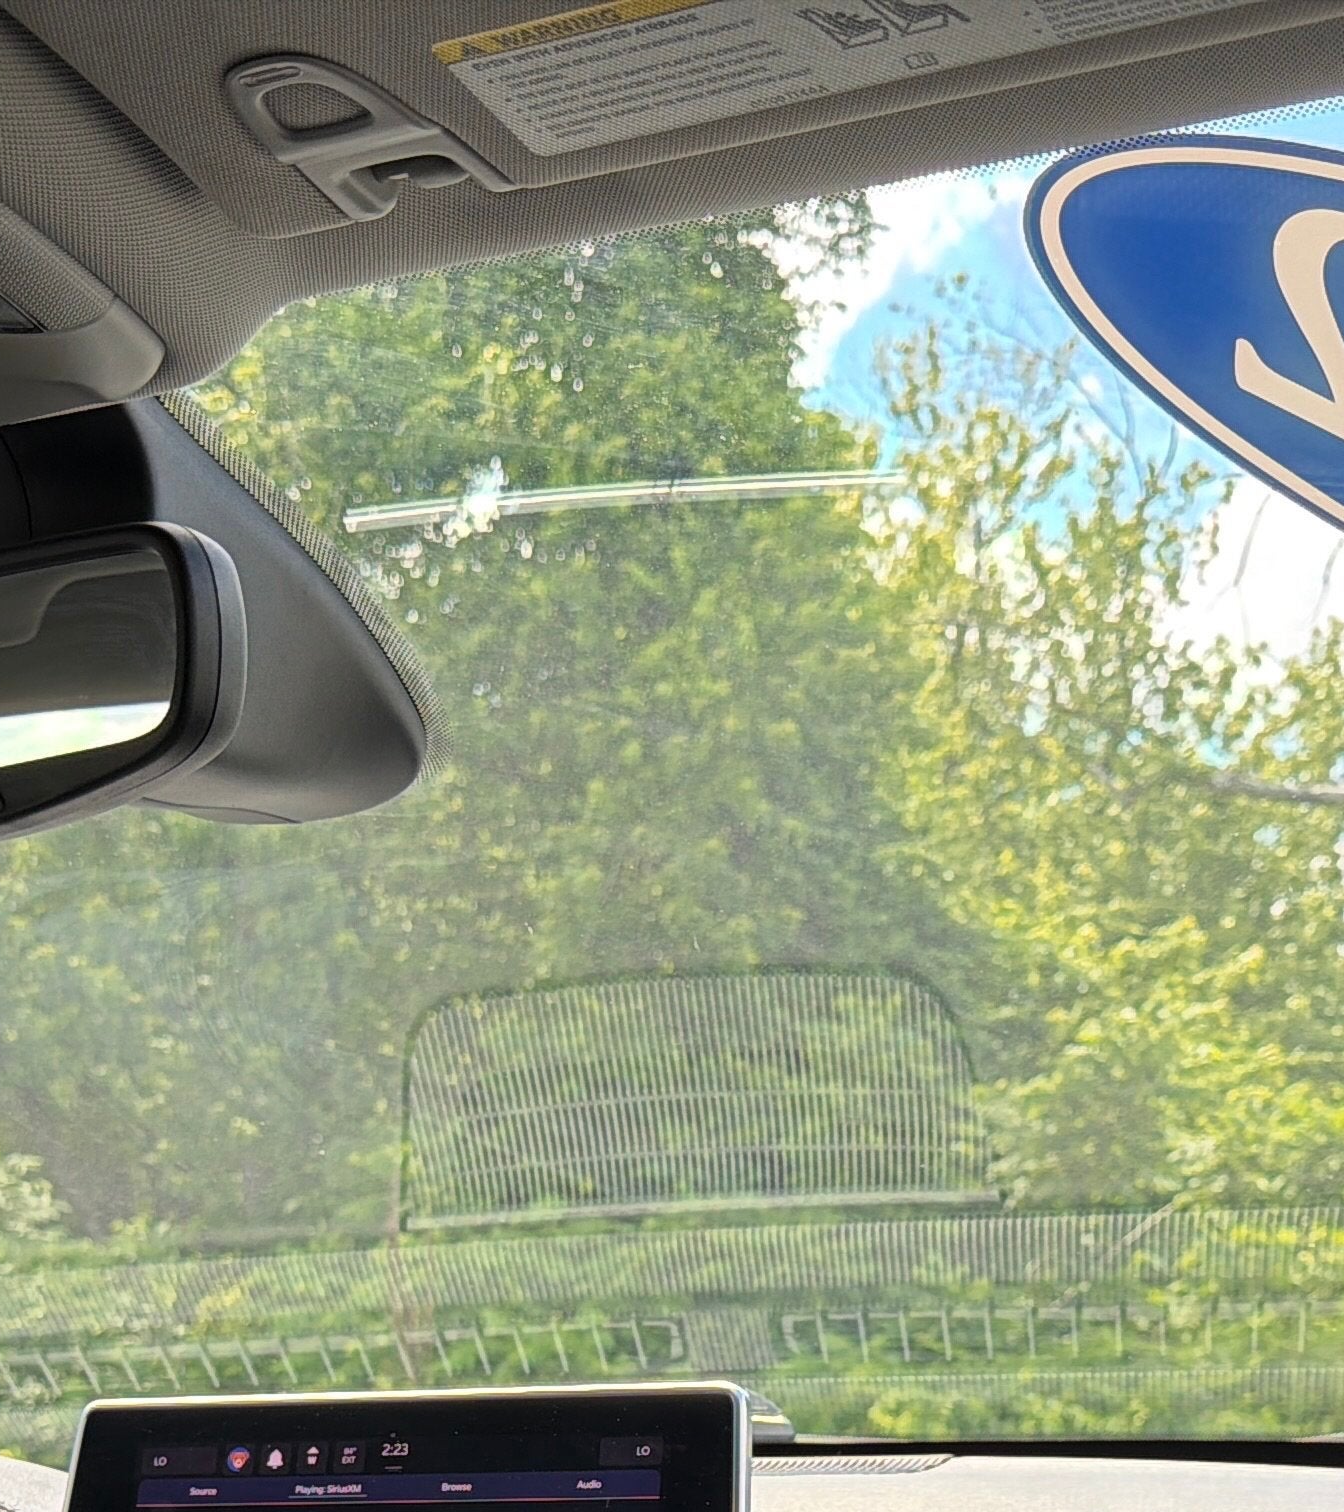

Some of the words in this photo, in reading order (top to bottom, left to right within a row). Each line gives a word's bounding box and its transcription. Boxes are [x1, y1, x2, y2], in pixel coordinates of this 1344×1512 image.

[496, 8, 621, 47] WARNING
[633, 12, 701, 34] AIRBAGS
[381, 1443, 409, 1457] 2:23
[636, 1446, 651, 1457] LO
[154, 1456, 167, 1467] LO
[295, 1485, 325, 1496] Playing:
[327, 1484, 362, 1494] SiriusXM
[441, 1482, 473, 1492] Browse
[576, 1480, 603, 1490] Audio
[189, 1487, 218, 1497] Source
